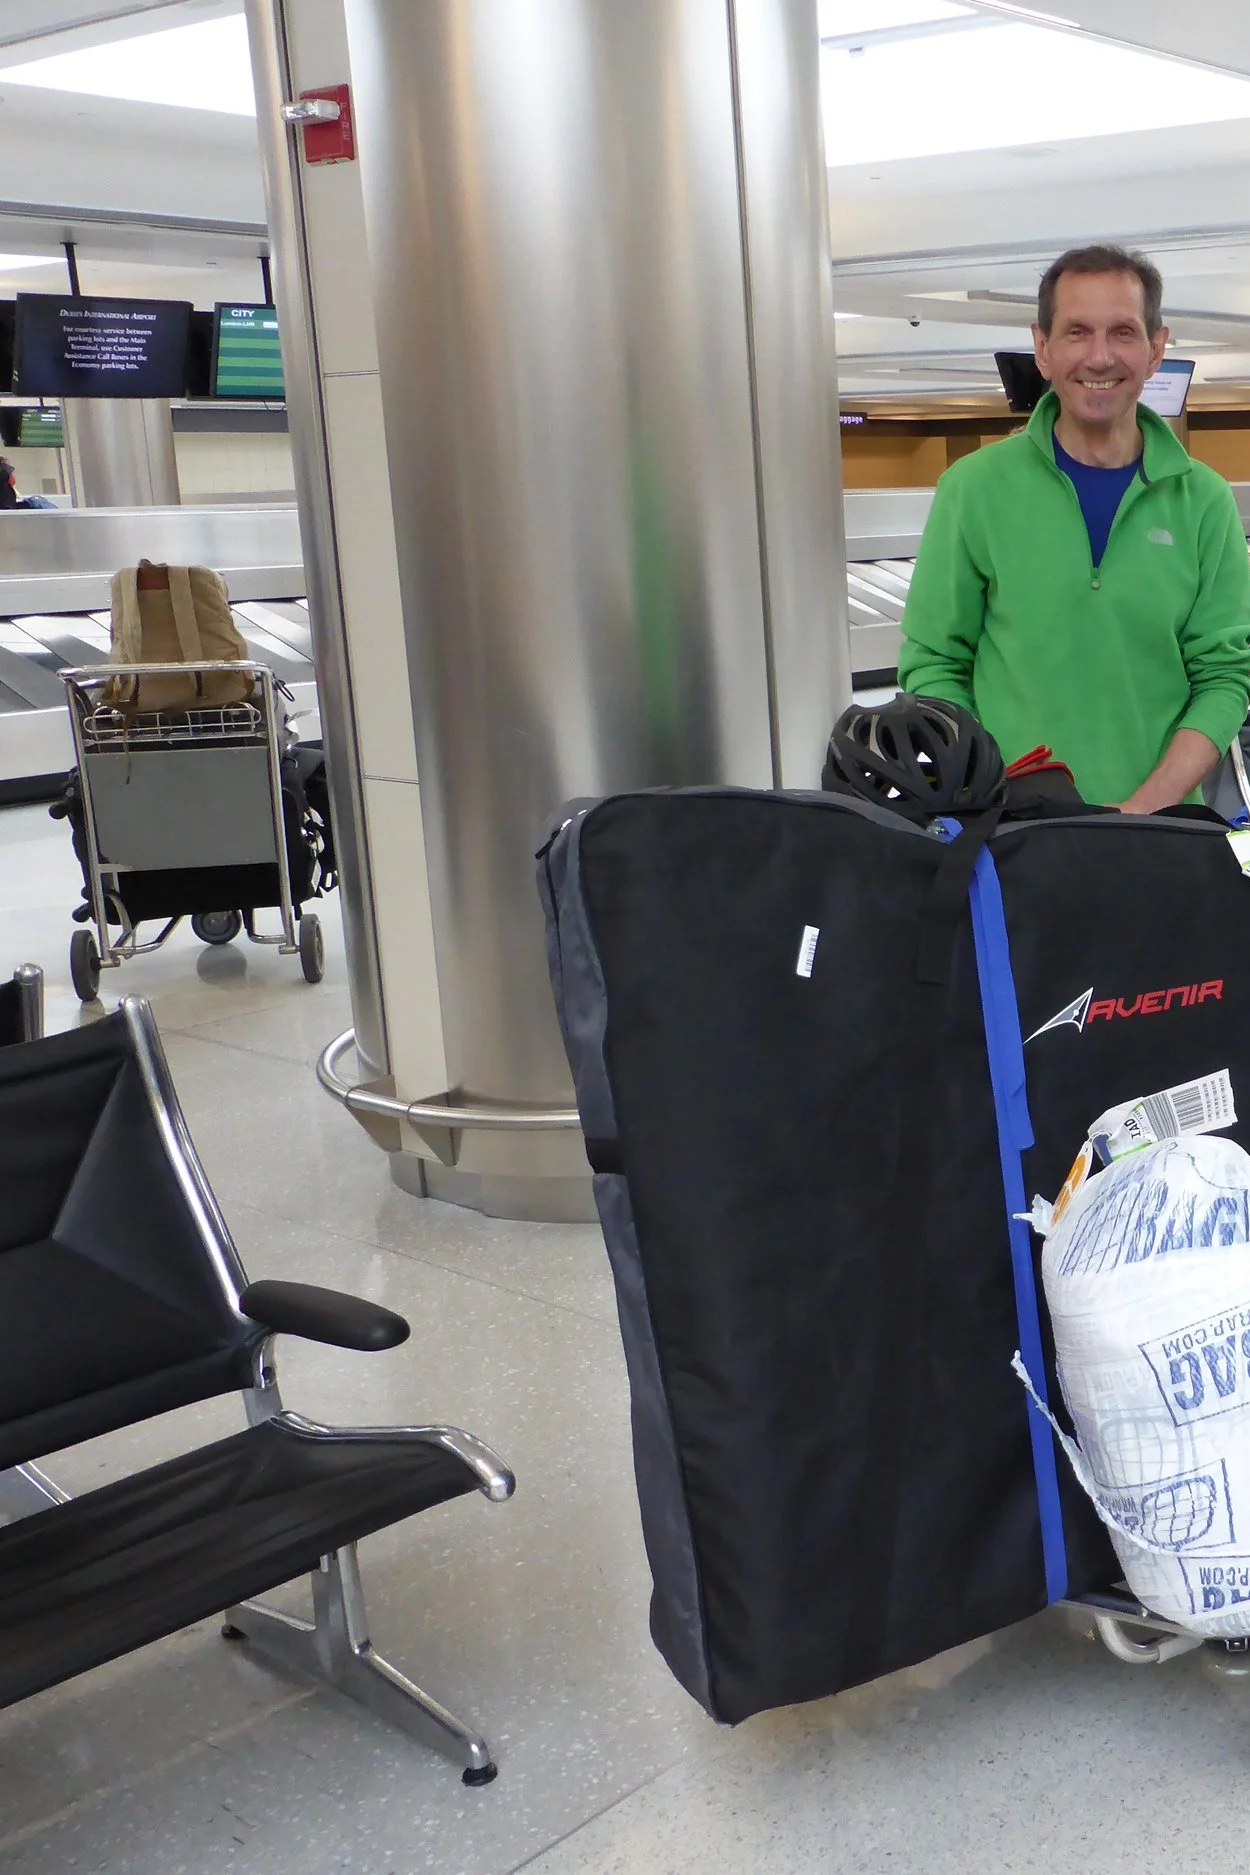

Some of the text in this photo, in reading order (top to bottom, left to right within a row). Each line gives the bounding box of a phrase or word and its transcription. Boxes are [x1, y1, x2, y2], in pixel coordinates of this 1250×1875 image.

[340, 102, 351, 141] FIRE
[231, 309, 255, 317] CITY
[67, 334, 92, 343] parking
[113, 344, 143, 352] Customer
[72, 361, 100, 369] Economy
[101, 362, 126, 371] parking
[840, 416, 863, 424] aggage
[1087, 979, 1224, 1024] AVENIR
[1123, 1118, 1142, 1140] IAD
